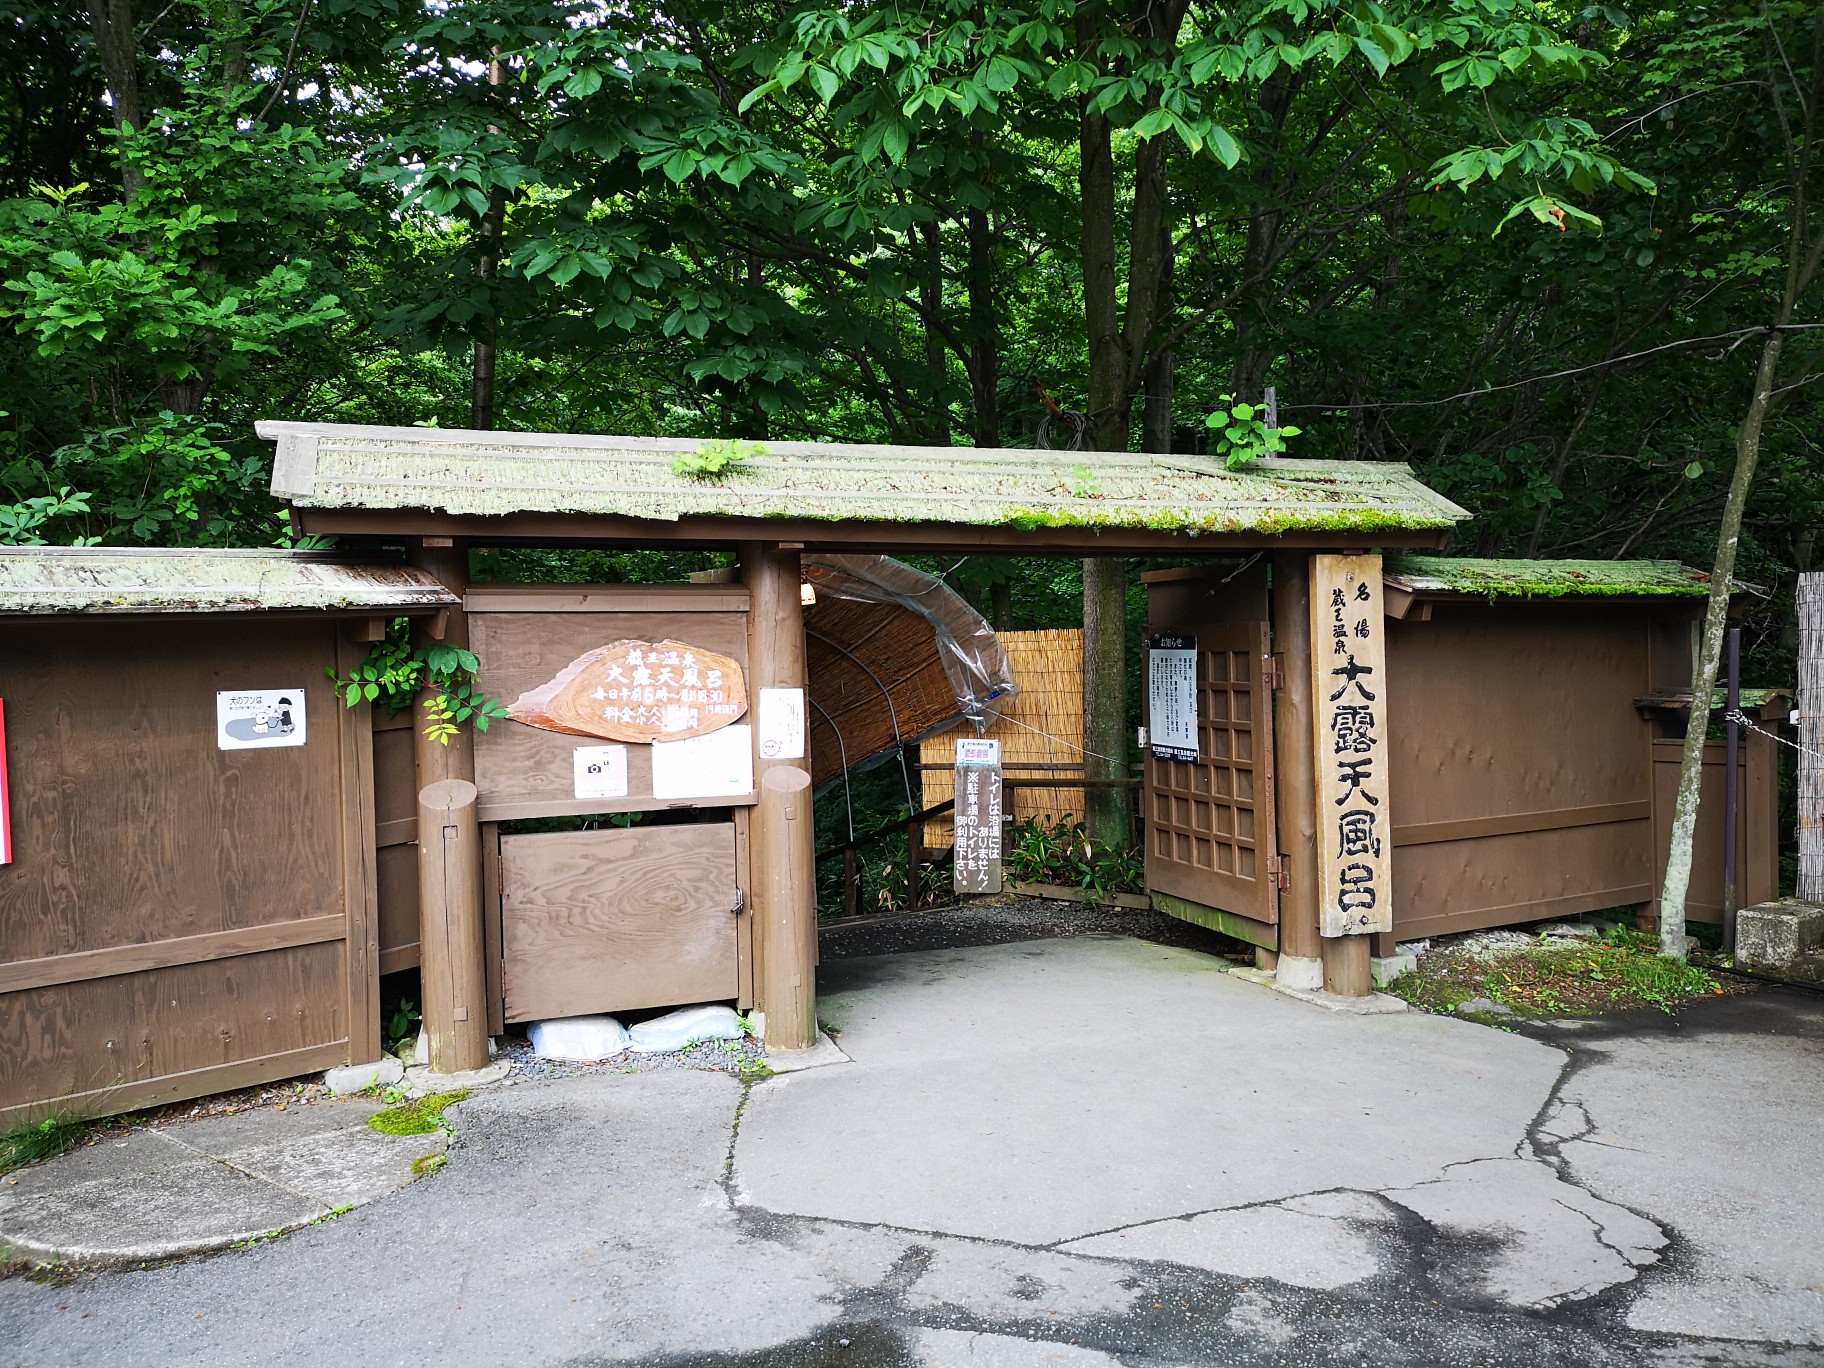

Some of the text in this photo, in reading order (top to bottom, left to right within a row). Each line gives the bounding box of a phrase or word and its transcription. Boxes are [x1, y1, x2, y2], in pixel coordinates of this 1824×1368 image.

[1330, 588, 1348, 655] 蔵王温泉
[1160, 637, 1183, 648] お知らせ
[625, 648, 698, 668] 蔵王温泉
[605, 665, 723, 688] 大露天風呂
[229, 696, 263, 706] 犬のフンは
[603, 706, 635, 724] 料金
[1329, 654, 1381, 913] 大露天風呂
[988, 772, 1000, 860] トイレは浴場には
[956, 815, 968, 886] 御利用下さい。
